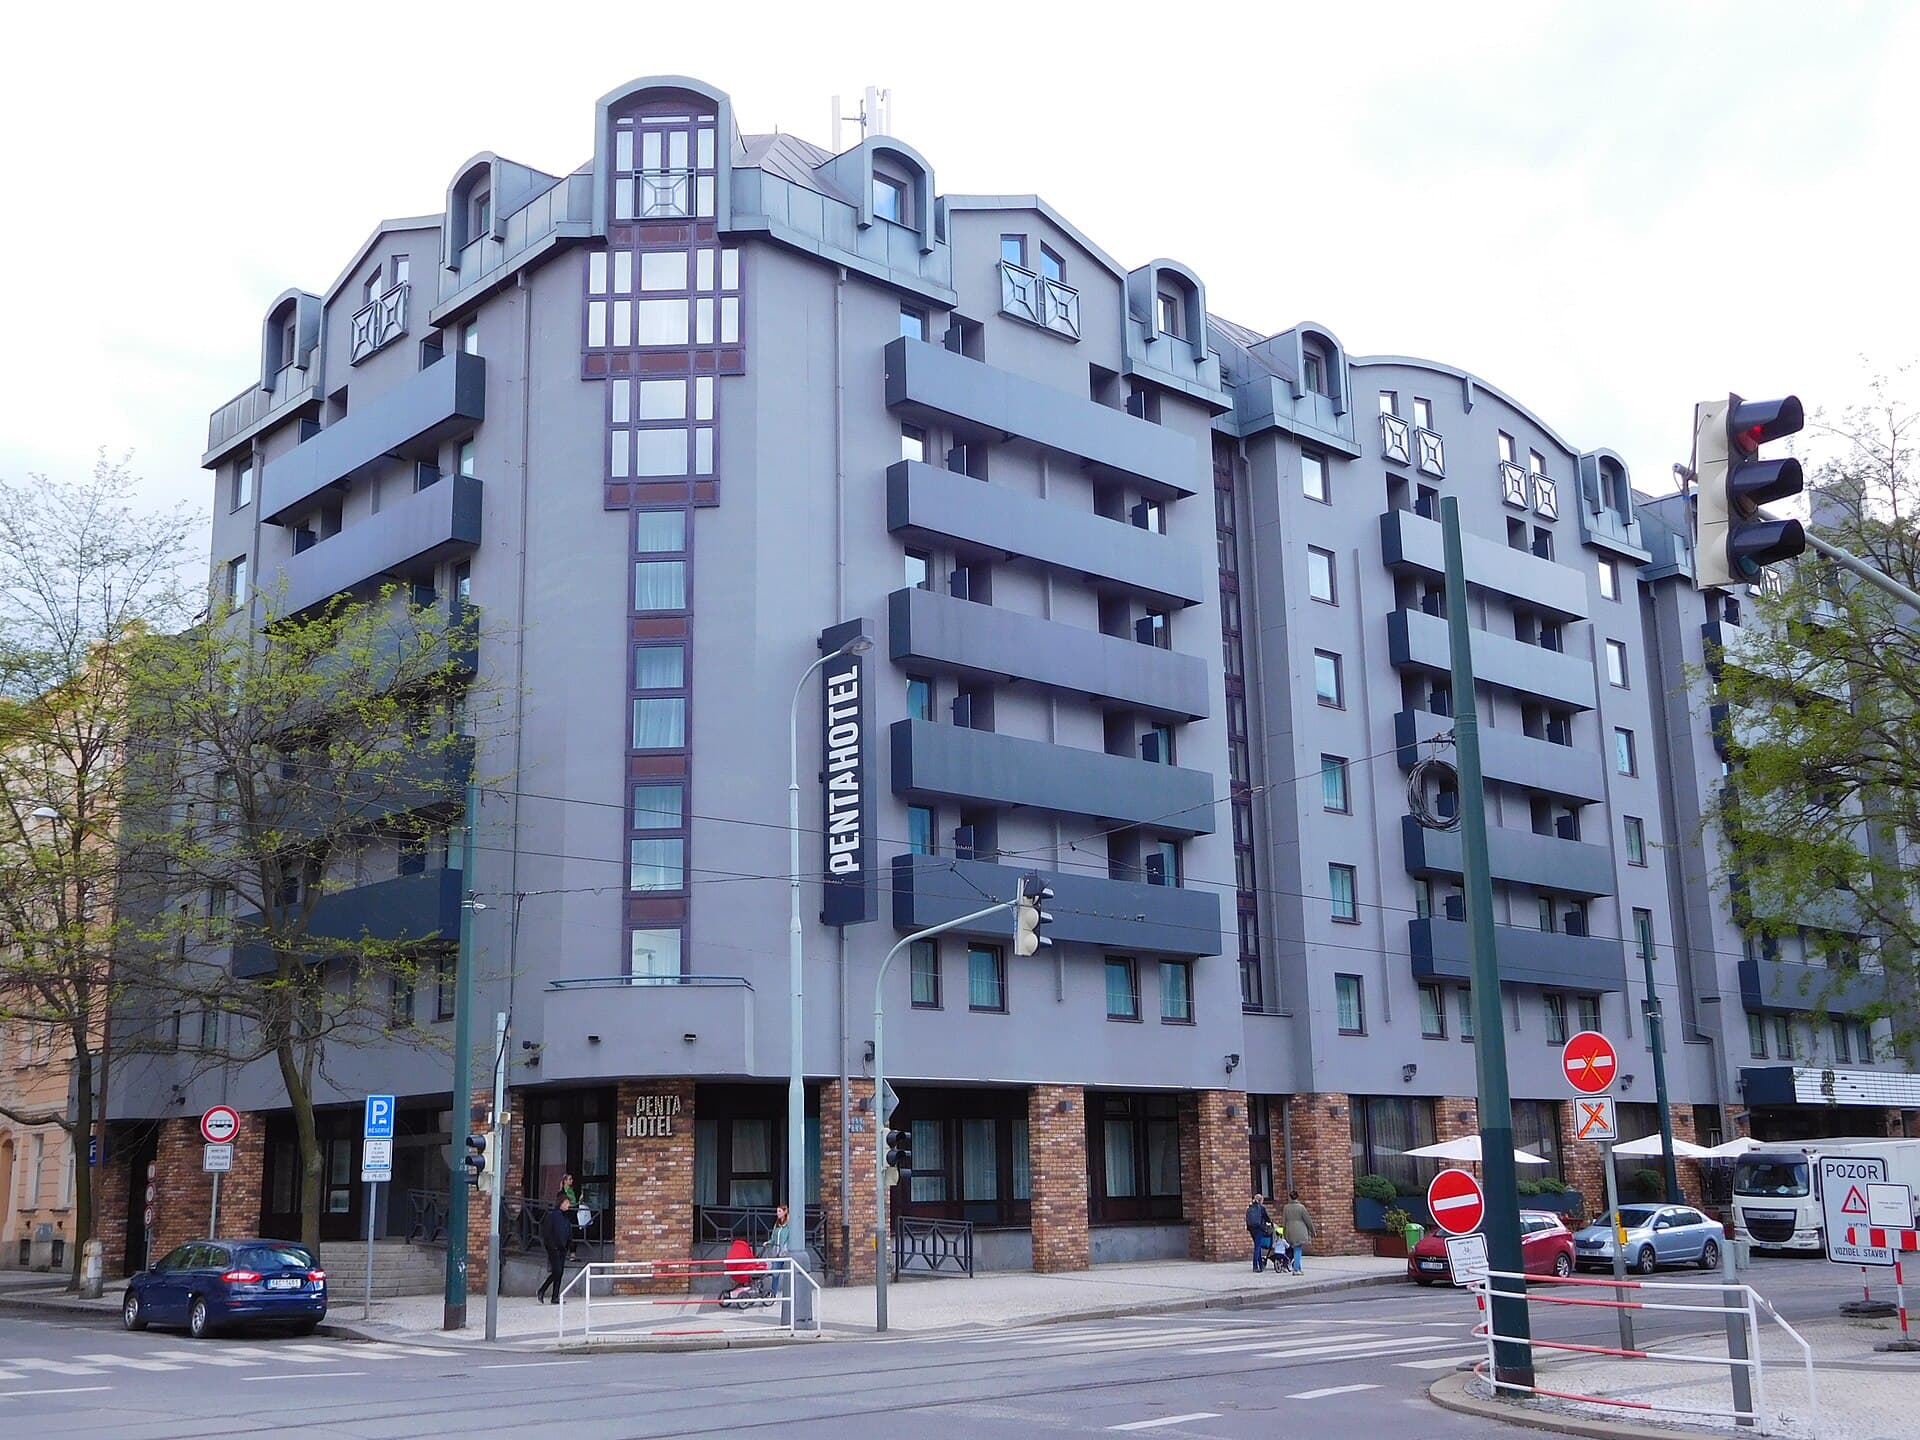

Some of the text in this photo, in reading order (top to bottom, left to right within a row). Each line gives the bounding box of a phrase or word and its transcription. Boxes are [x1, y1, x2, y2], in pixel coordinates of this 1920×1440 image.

[828, 664, 860, 874] PENTAHOTEL
[372, 1100, 388, 1124] P
[636, 1095, 682, 1116] PENTA
[626, 1116, 673, 1137] HOTEL
[1826, 1163, 1879, 1180] POZOR
[1834, 1247, 1888, 1259] VOZIDEL STAVBY
